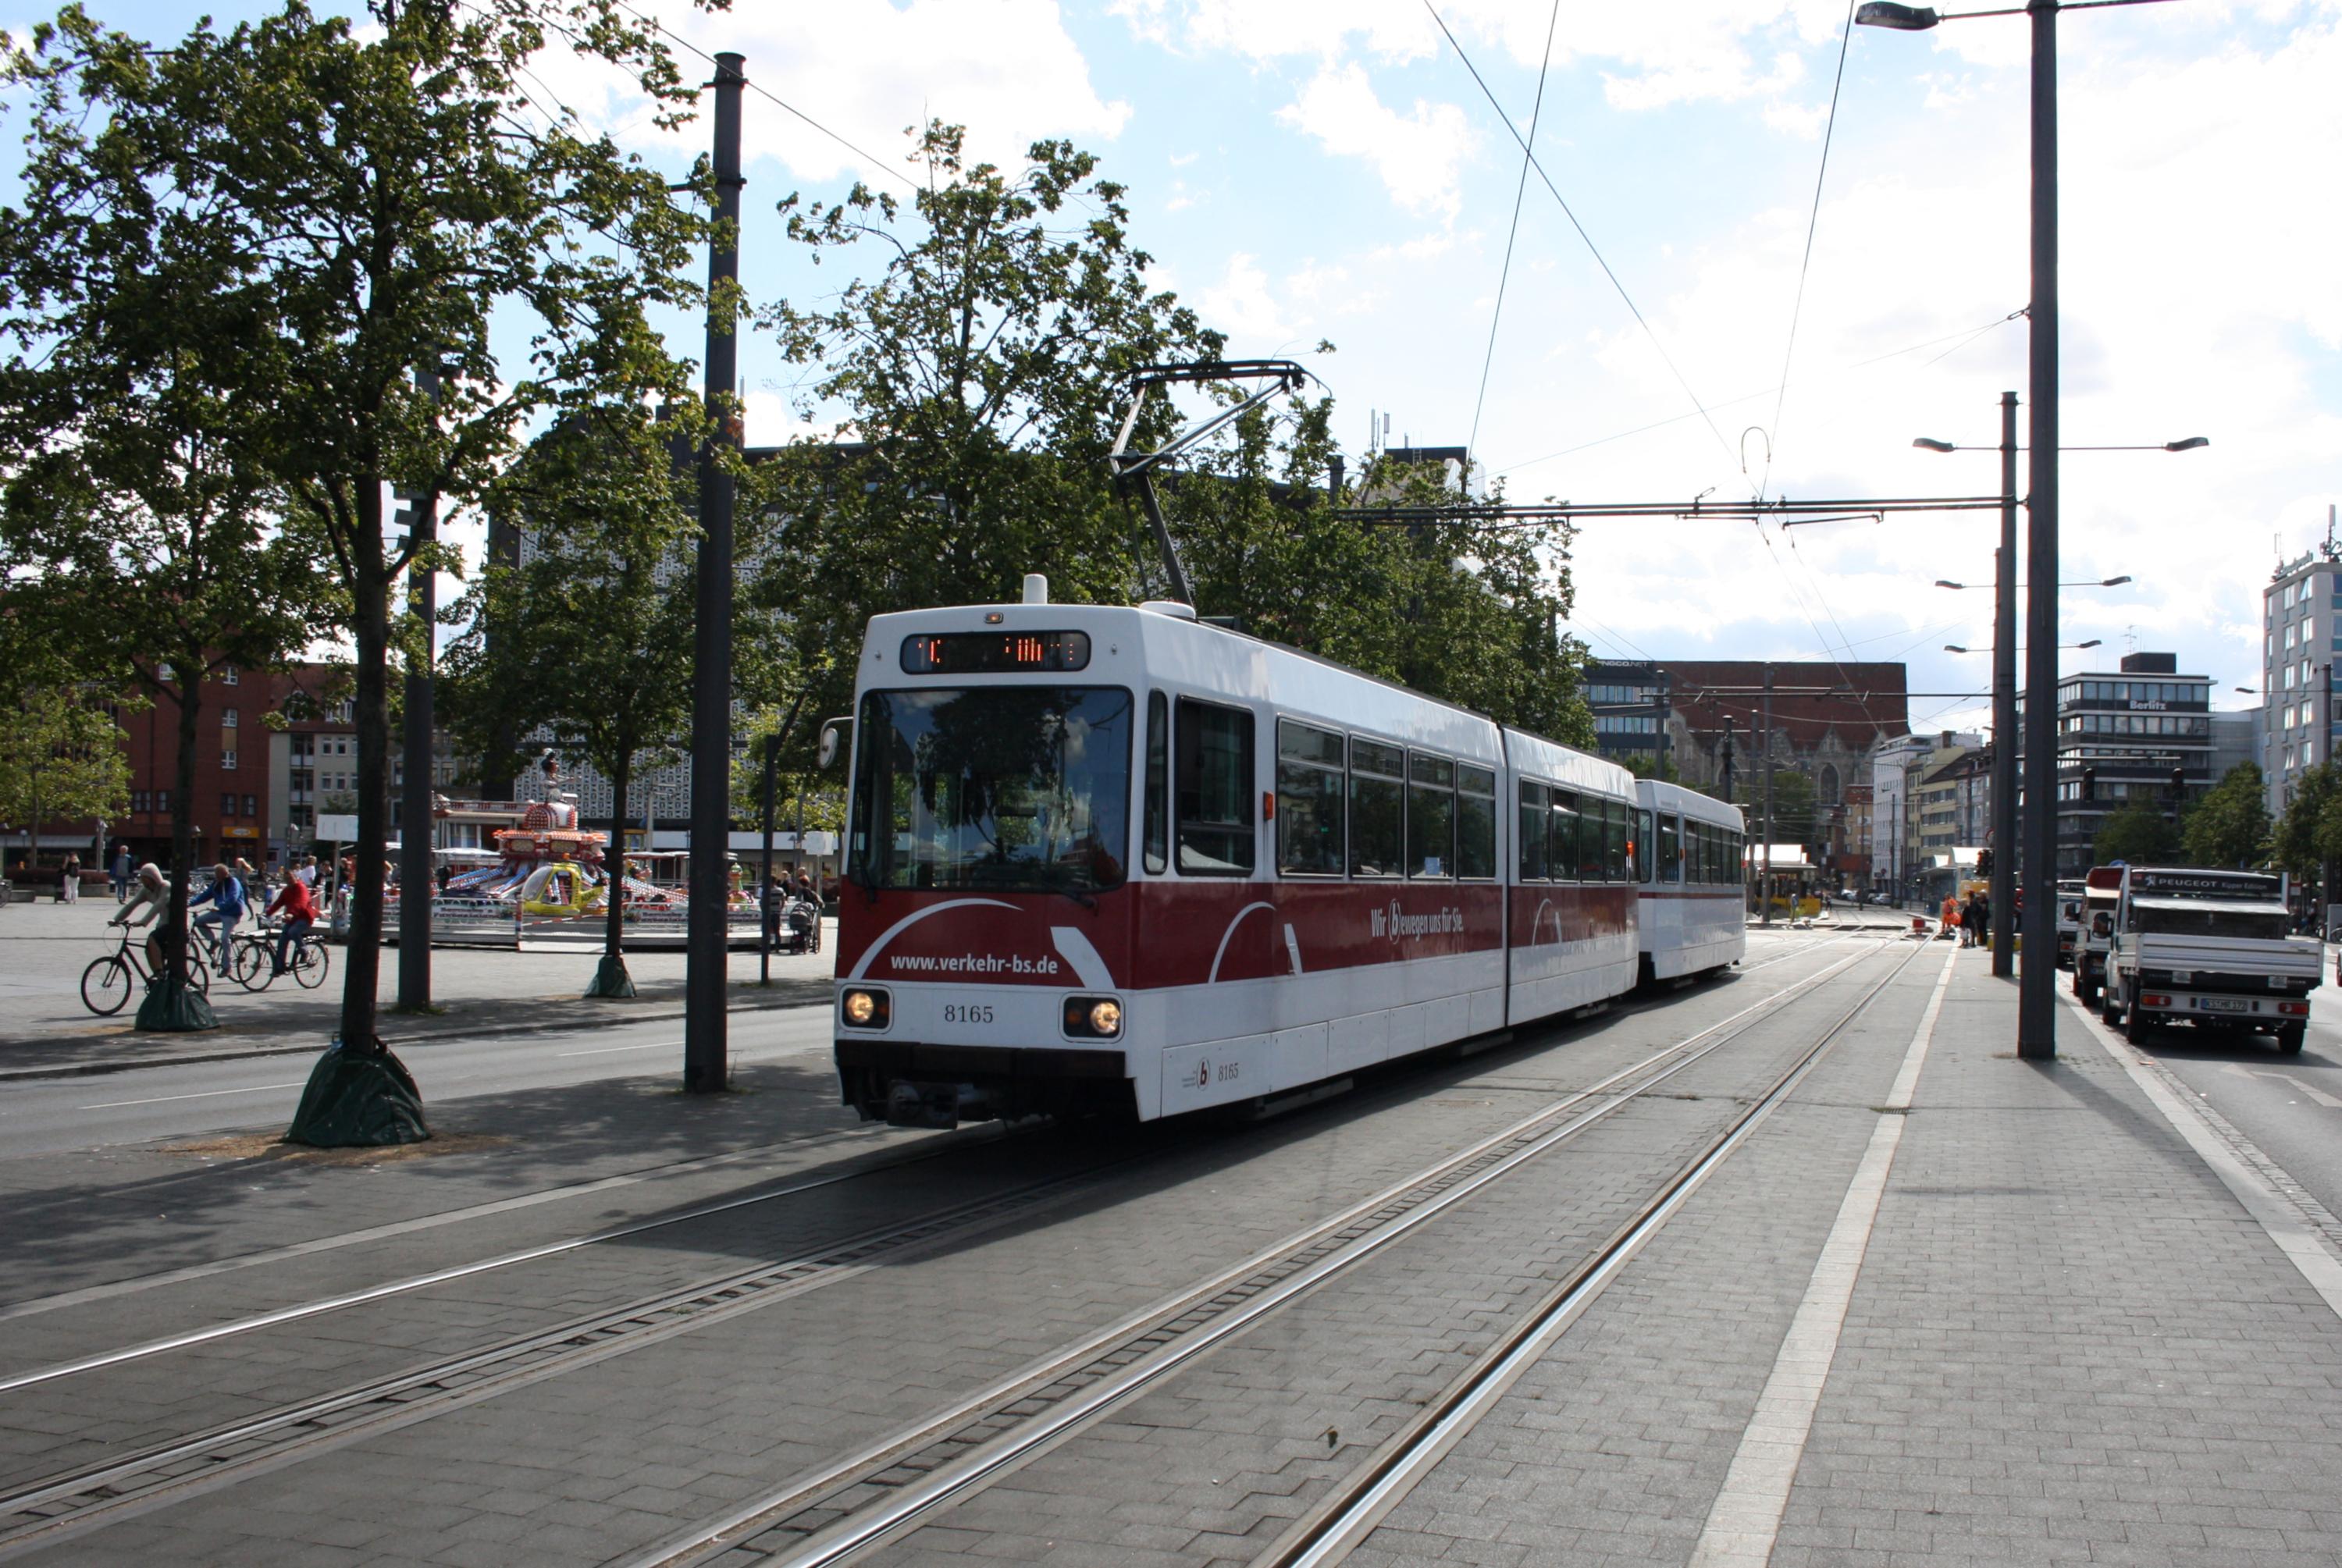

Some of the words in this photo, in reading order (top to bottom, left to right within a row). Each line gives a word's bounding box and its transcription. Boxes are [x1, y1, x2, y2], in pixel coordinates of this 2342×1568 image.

[2130, 700, 2166, 710] Berlitz
[2159, 877, 2218, 887] PEUGEOT
[1371, 908, 1386, 937] Wir
[1388, 898, 1429, 943] bewegen
[1429, 914, 1441, 934] uns
[1442, 906, 1452, 933] für
[1452, 907, 1464, 933] Sie.
[891, 953, 1059, 975] www.verkehr-bs.de
[944, 1004, 994, 1024] 8165
[1218, 1062, 1239, 1083] 8165
